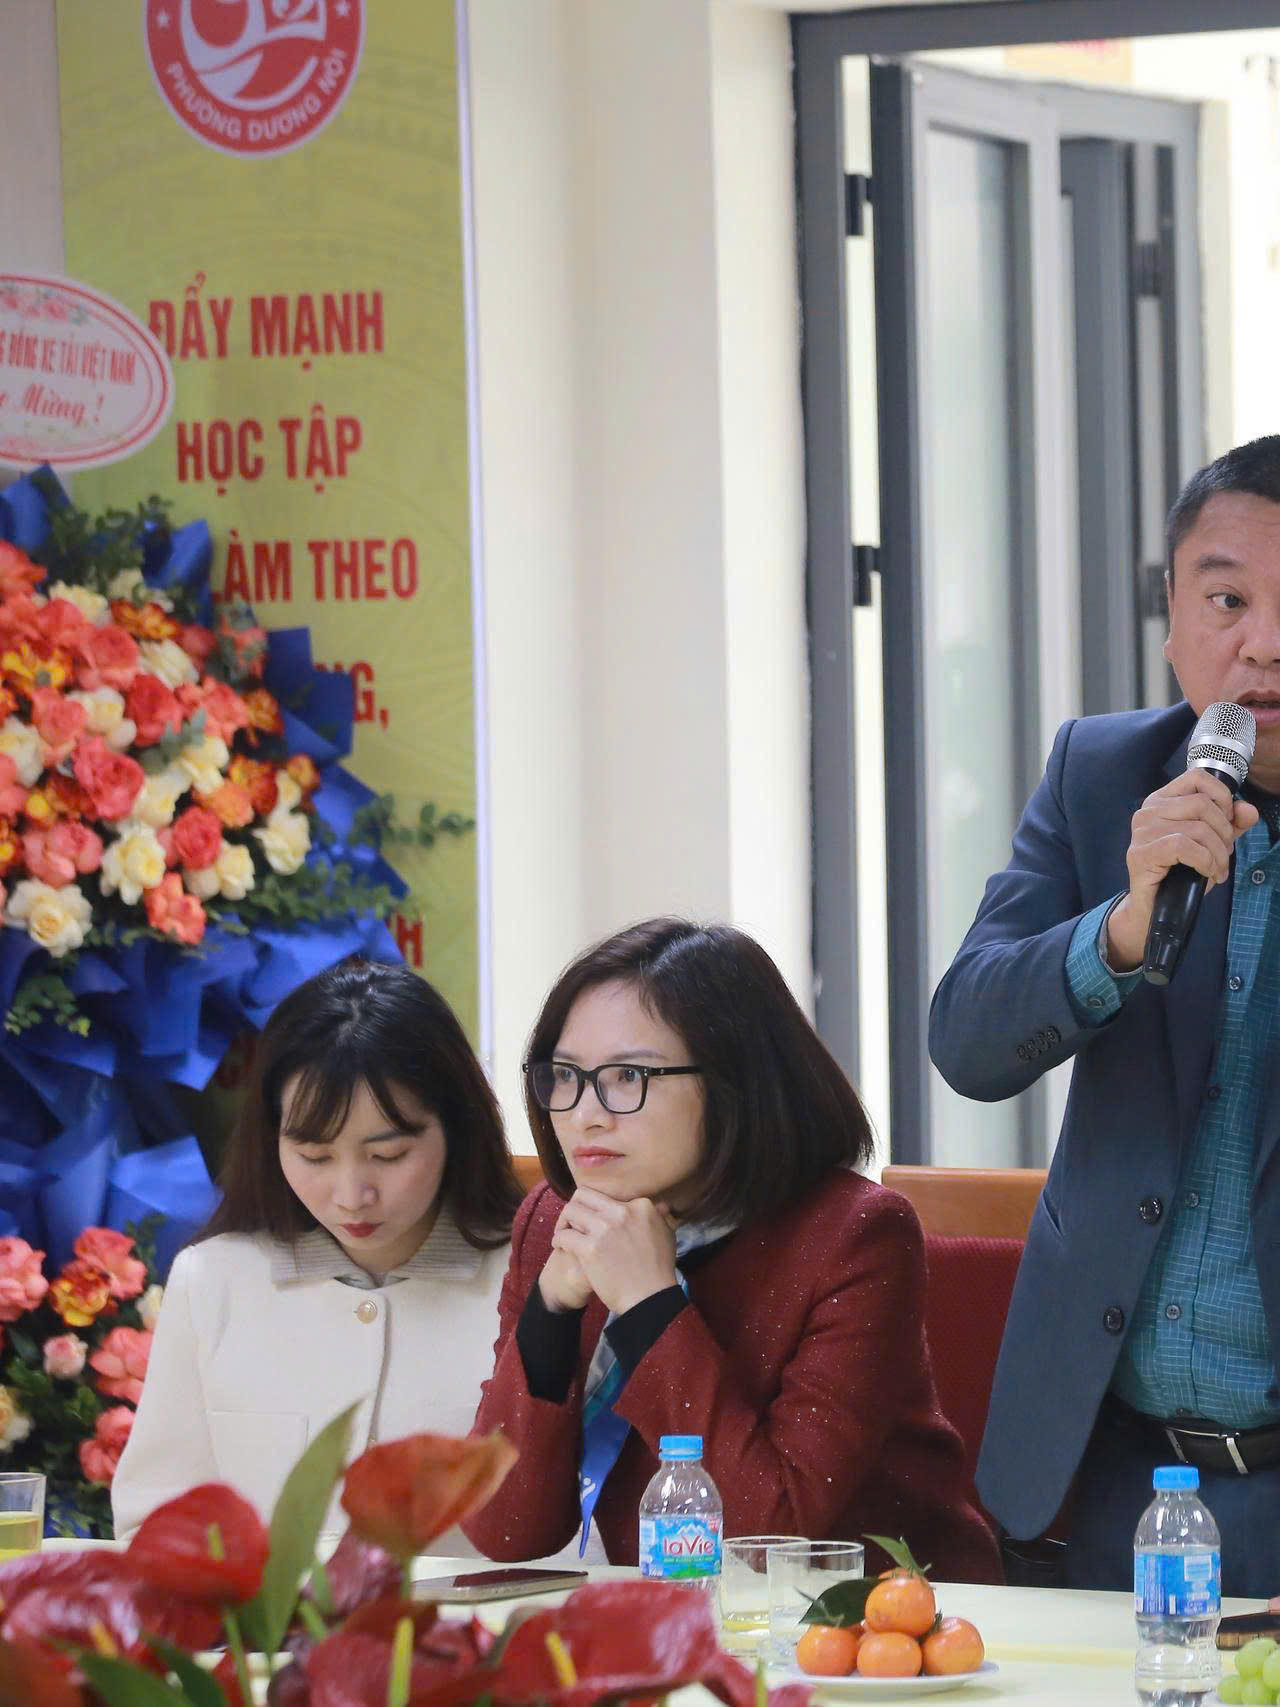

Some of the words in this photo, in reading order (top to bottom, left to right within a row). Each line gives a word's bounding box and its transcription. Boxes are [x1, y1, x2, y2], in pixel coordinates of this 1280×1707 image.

[149, 271, 234, 360] ĐẨY
[250, 290, 384, 371] MẠNH
[176, 418, 264, 496] HỌC
[278, 403, 363, 493] TẬP
[307, 538, 419, 604] THEO
